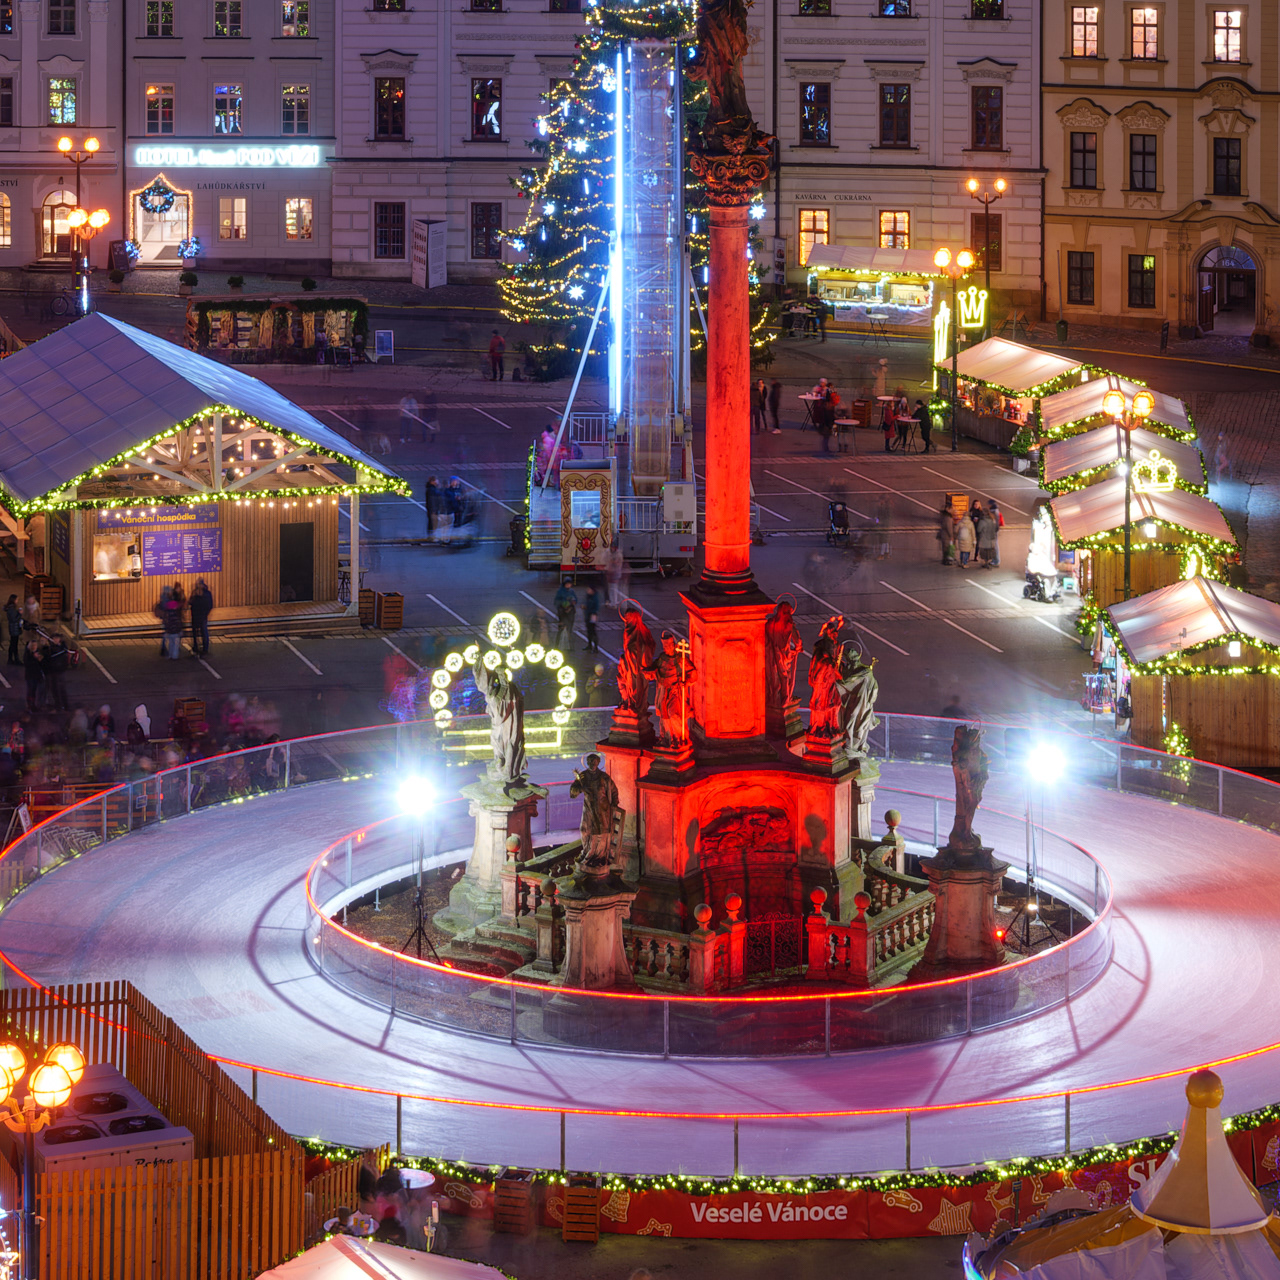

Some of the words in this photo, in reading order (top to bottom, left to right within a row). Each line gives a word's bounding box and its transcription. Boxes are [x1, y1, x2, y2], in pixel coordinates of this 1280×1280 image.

[137, 149, 197, 165] HOTEL
[197, 182, 266, 190] LAHŮDKÁŘSTVÍ
[834, 193, 872, 201] CUKRÁRNA
[121, 516, 155, 524] Vánoční
[157, 513, 196, 523] hospůdka
[690, 1202, 762, 1222] Veselé
[766, 1201, 848, 1222] Vánoce
